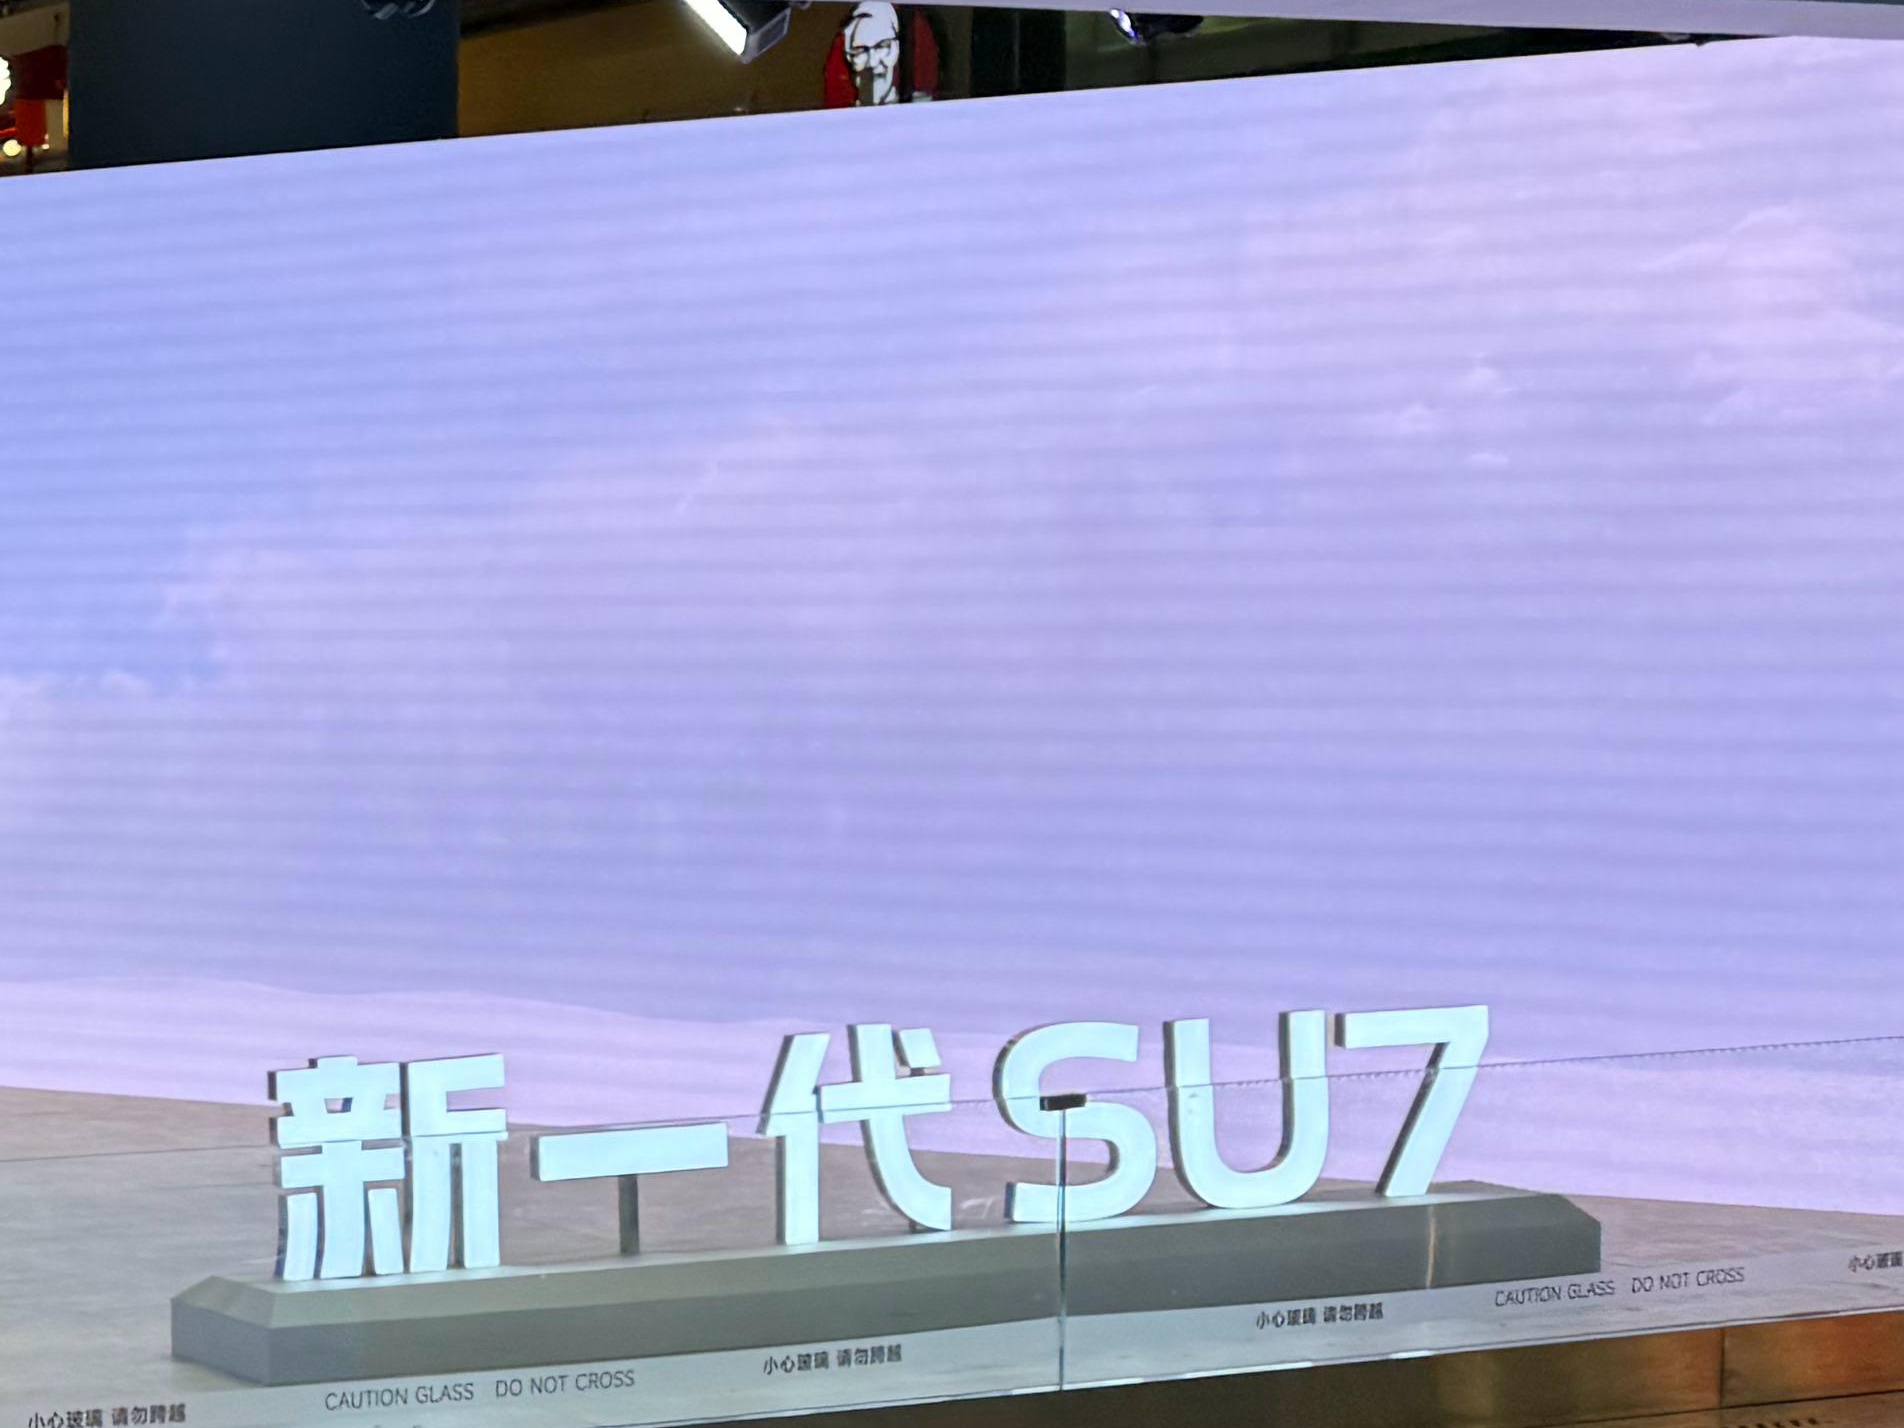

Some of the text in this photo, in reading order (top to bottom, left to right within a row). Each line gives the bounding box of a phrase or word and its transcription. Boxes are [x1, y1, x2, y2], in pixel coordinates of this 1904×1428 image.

[1495, 1267, 1745, 1307] CAUTION GLASS DO NOT CROSS
[325, 1369, 635, 1411] CAUTION GLASS DO NOT CROSS
